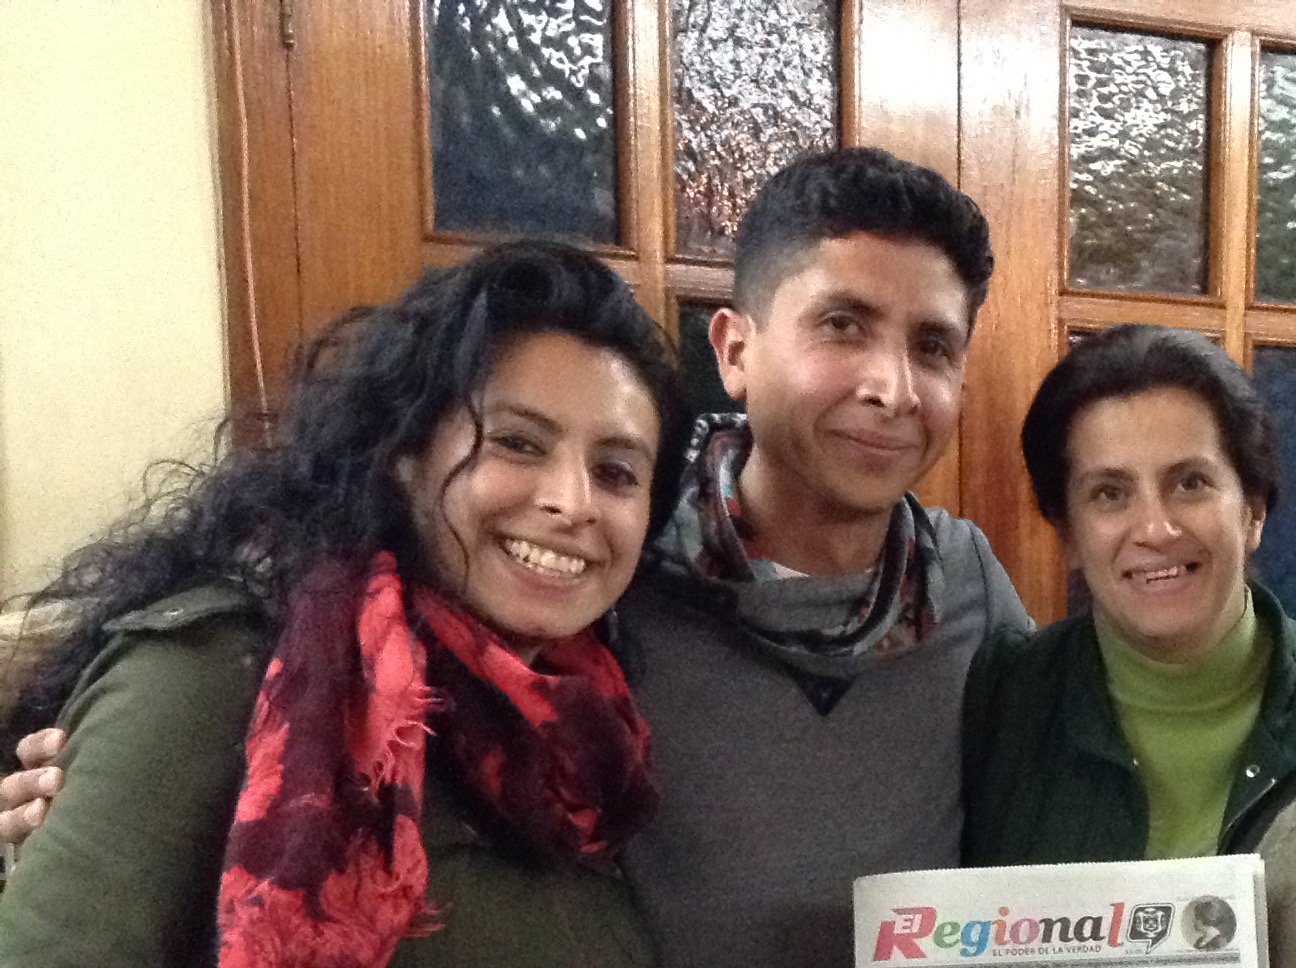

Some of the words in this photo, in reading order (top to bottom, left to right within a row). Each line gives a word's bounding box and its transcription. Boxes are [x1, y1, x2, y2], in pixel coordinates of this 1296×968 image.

[873, 902, 1125, 961] Regional
[894, 914, 922, 934] El
[993, 949, 1002, 957] EL
[1005, 948, 1035, 956] PODER
[1038, 947, 1050, 955] DE
[1067, 945, 1101, 953] VERDAD
